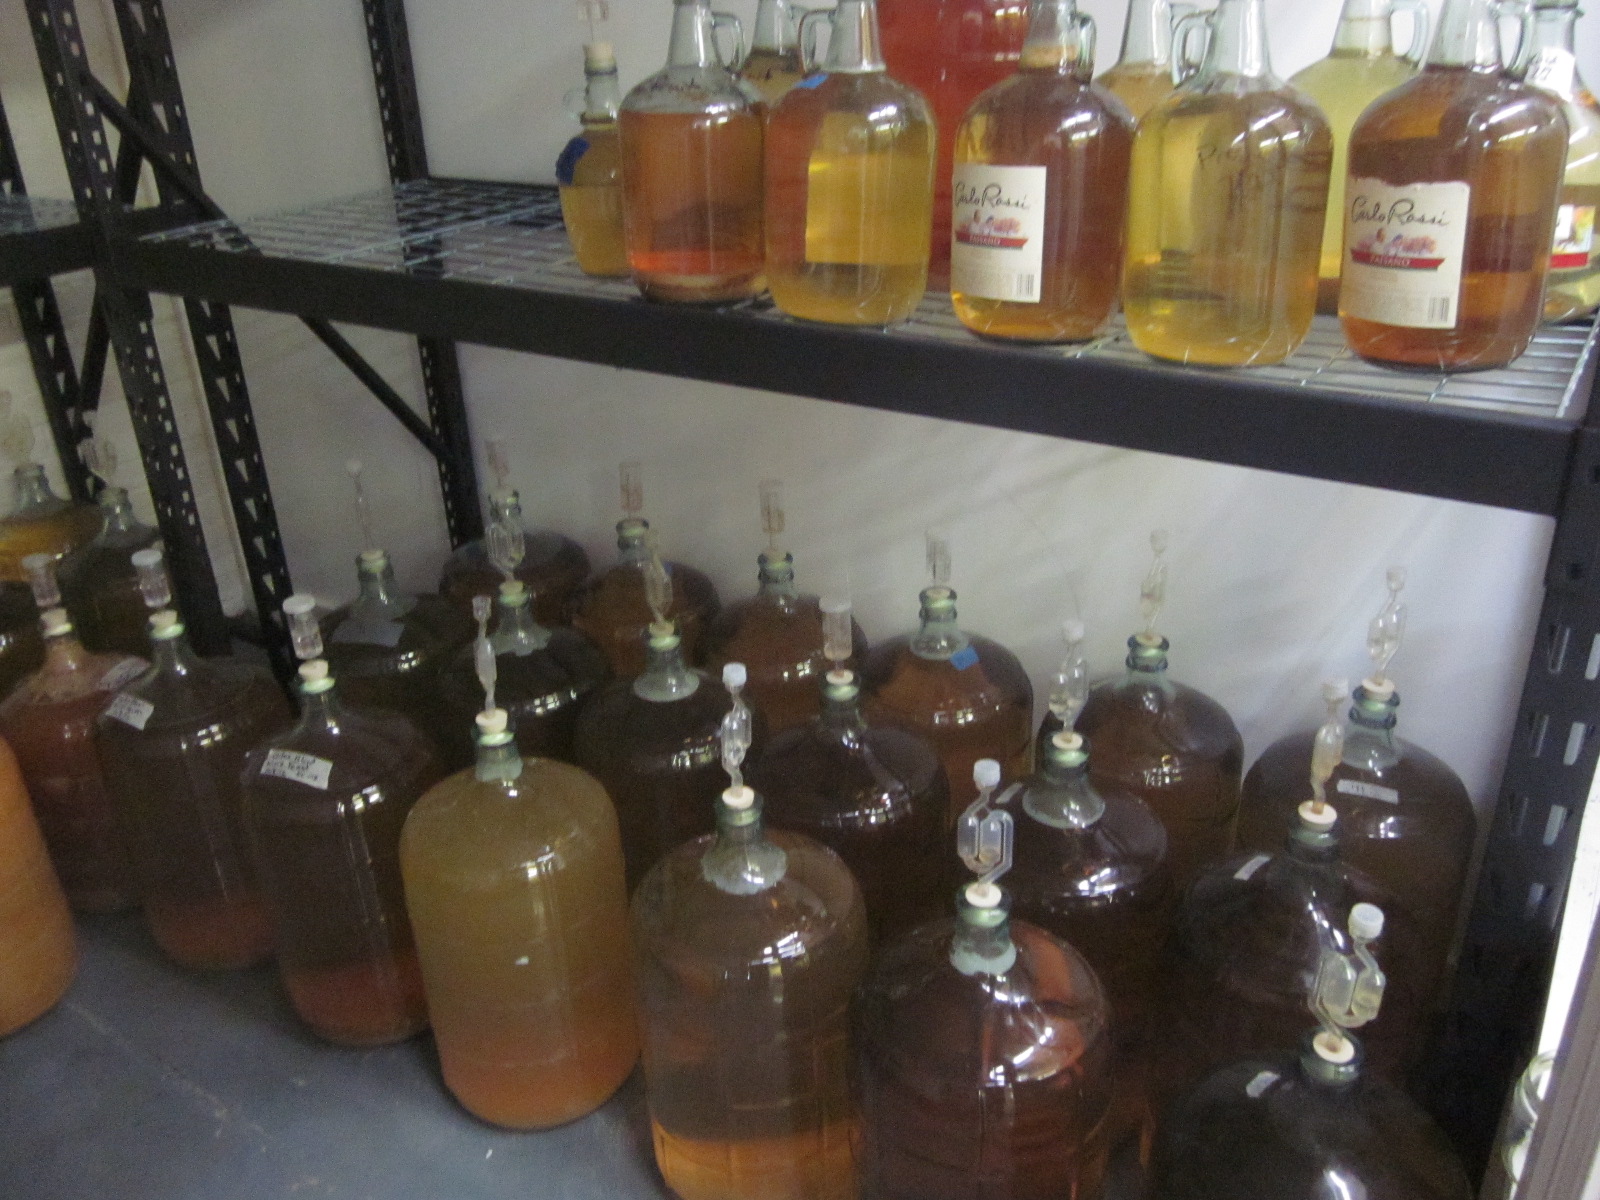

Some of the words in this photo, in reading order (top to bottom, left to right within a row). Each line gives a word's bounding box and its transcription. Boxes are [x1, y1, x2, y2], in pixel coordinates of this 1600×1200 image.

[955, 181, 980, 207] Carlo
[981, 183, 1030, 209] Rossi
[1351, 195, 1386, 223] Carlo
[1386, 198, 1449, 226] Rossi
[1369, 254, 1412, 267] PAISANO
